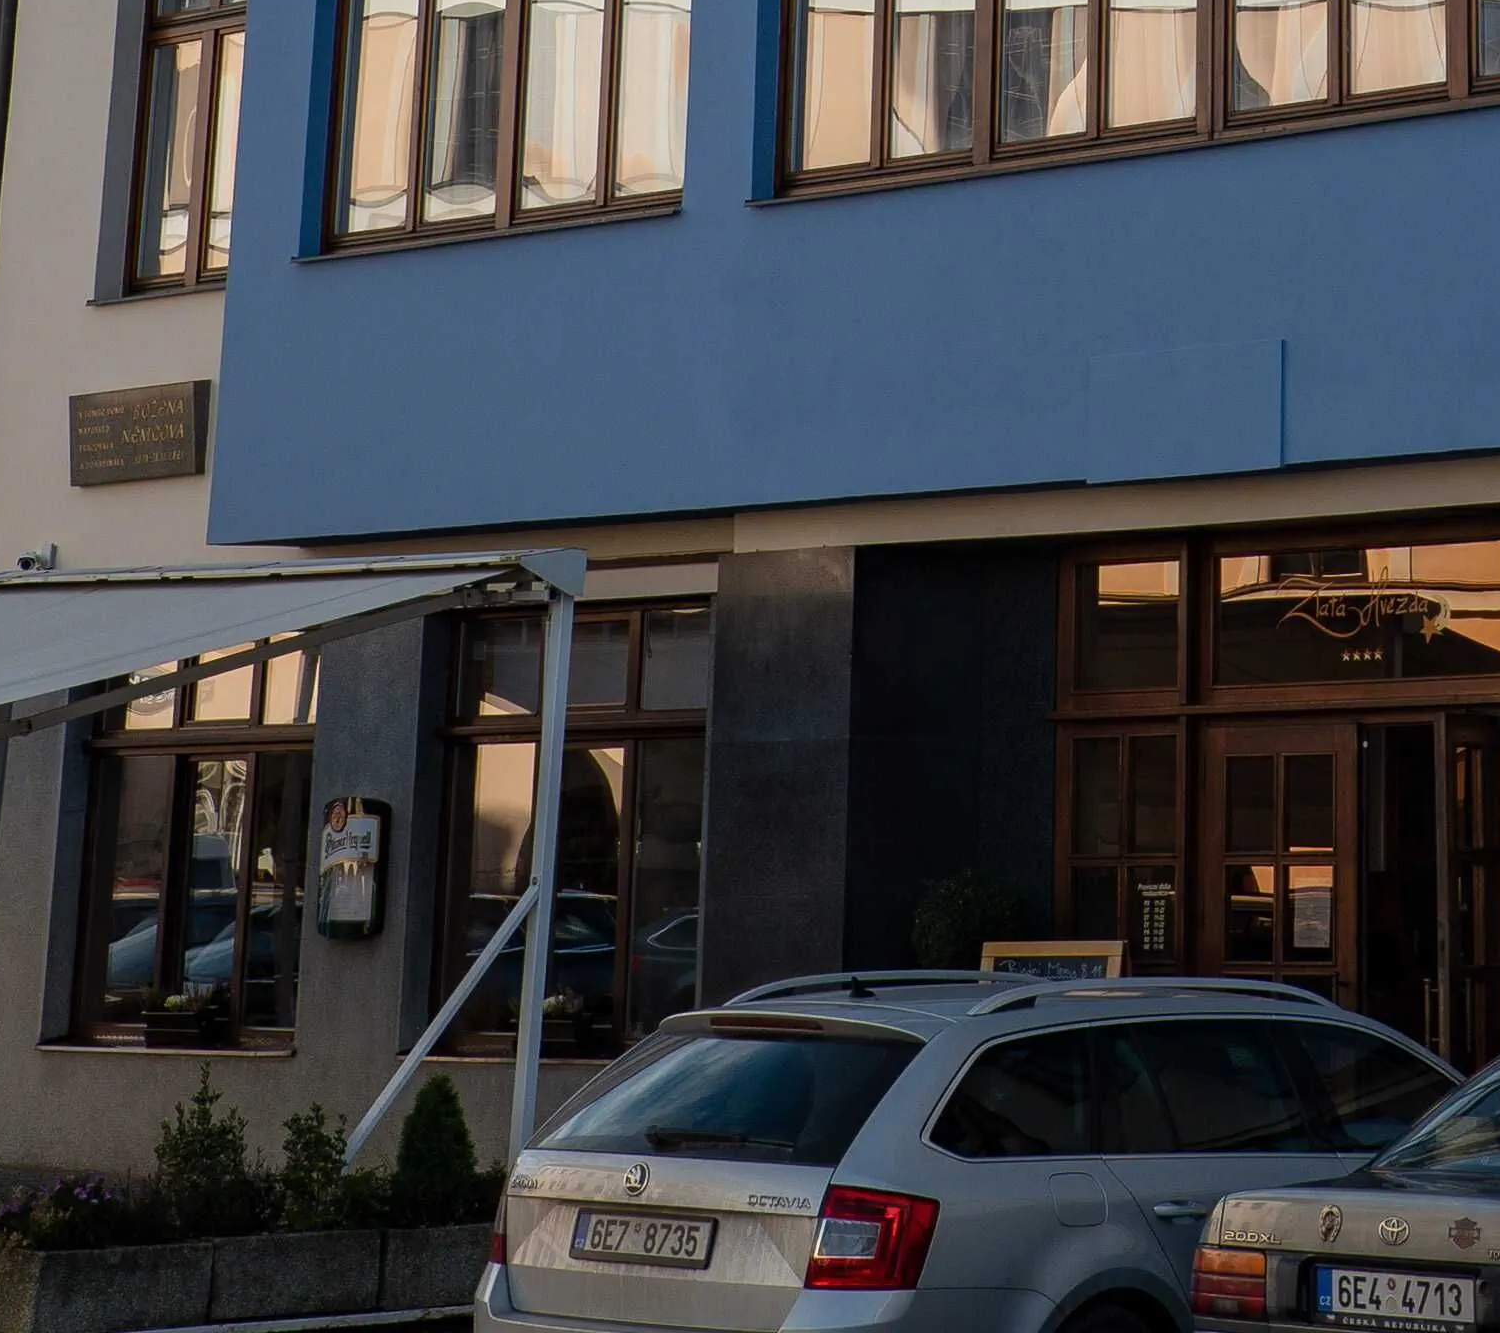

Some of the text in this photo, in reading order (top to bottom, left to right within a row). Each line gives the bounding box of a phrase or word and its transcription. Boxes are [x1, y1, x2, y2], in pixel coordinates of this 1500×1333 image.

[748, 1194, 811, 1209] OCTAVIA
[590, 1219, 631, 1251] 6E7
[643, 1223, 701, 1257] 8735
[1319, 1275, 1462, 1316] CZ 6E4 4713
